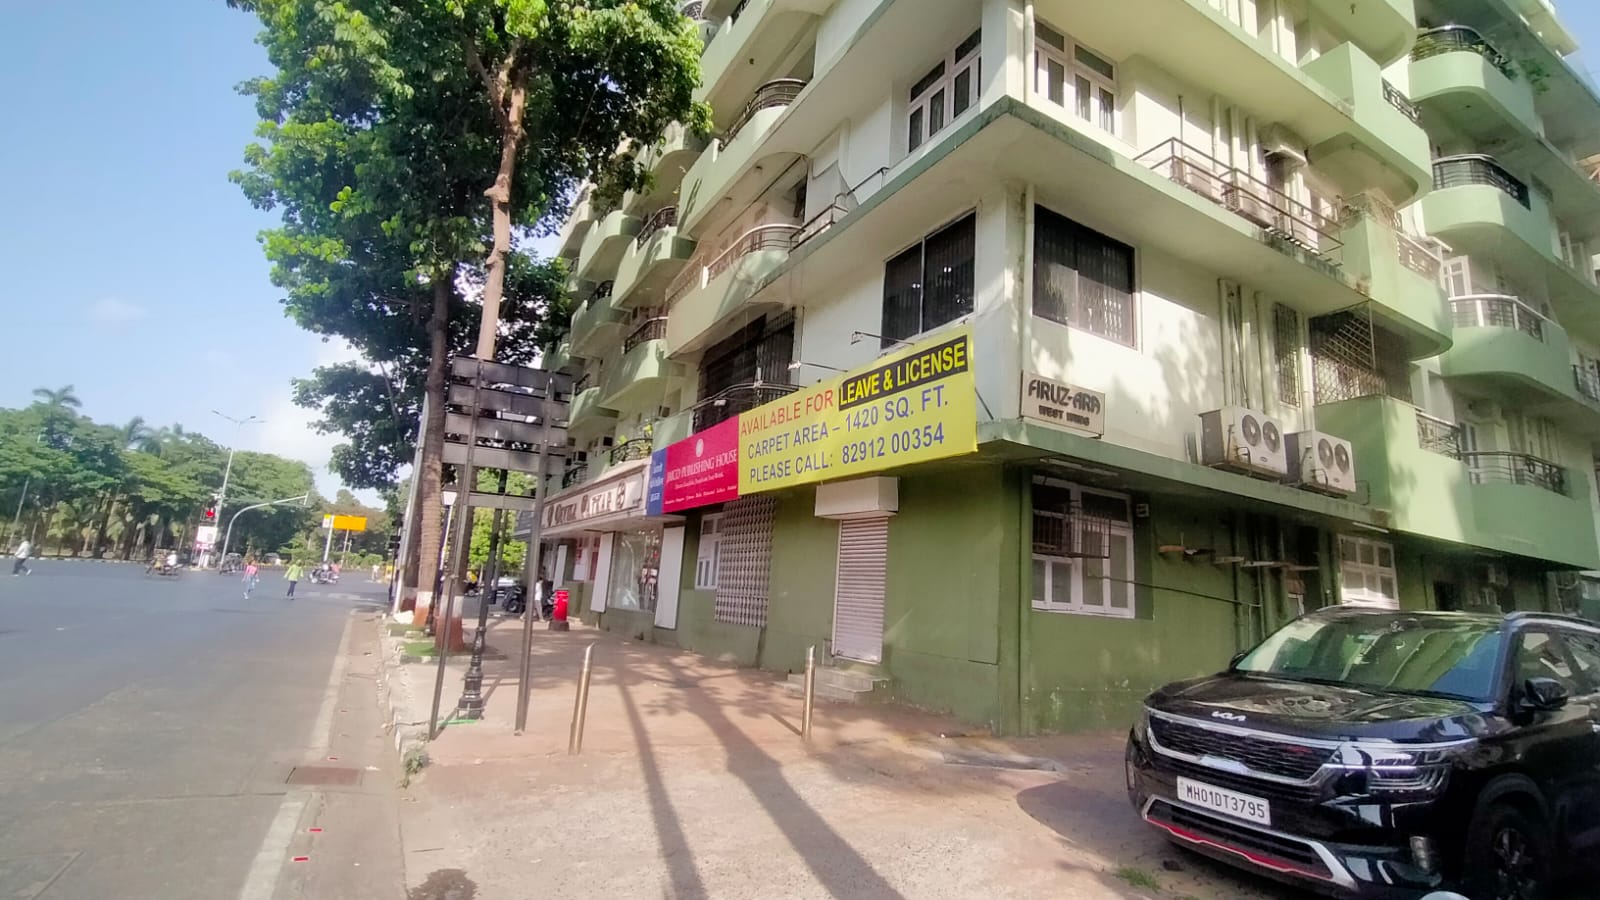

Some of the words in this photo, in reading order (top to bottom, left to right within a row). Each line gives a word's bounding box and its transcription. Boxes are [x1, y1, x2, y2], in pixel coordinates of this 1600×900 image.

[741, 402, 800, 437] AVAILABLE
[805, 390, 833, 414] FOR
[840, 374, 880, 404] LEAVE
[884, 369, 893, 391] &
[897, 342, 965, 386] LICENSE
[1028, 379, 1101, 415] FIRUZ-ARA
[748, 433, 789, 459] CARPET
[793, 422, 828, 446] AREA
[845, 409, 879, 432] 1420
[884, 396, 914, 421] SQ.
[922, 385, 948, 411] FT.
[1038, 405, 1064, 420] WEST
[681, 456, 714, 478] PUBLISHING
[716, 449, 737, 467] HOUSE
[751, 459, 790, 484] PLEASE
[795, 453, 833, 474] CALL:
[842, 436, 885, 464] 82912
[891, 422, 944, 451] 00354
[1186, 784, 1265, 818] MH01DT3795
